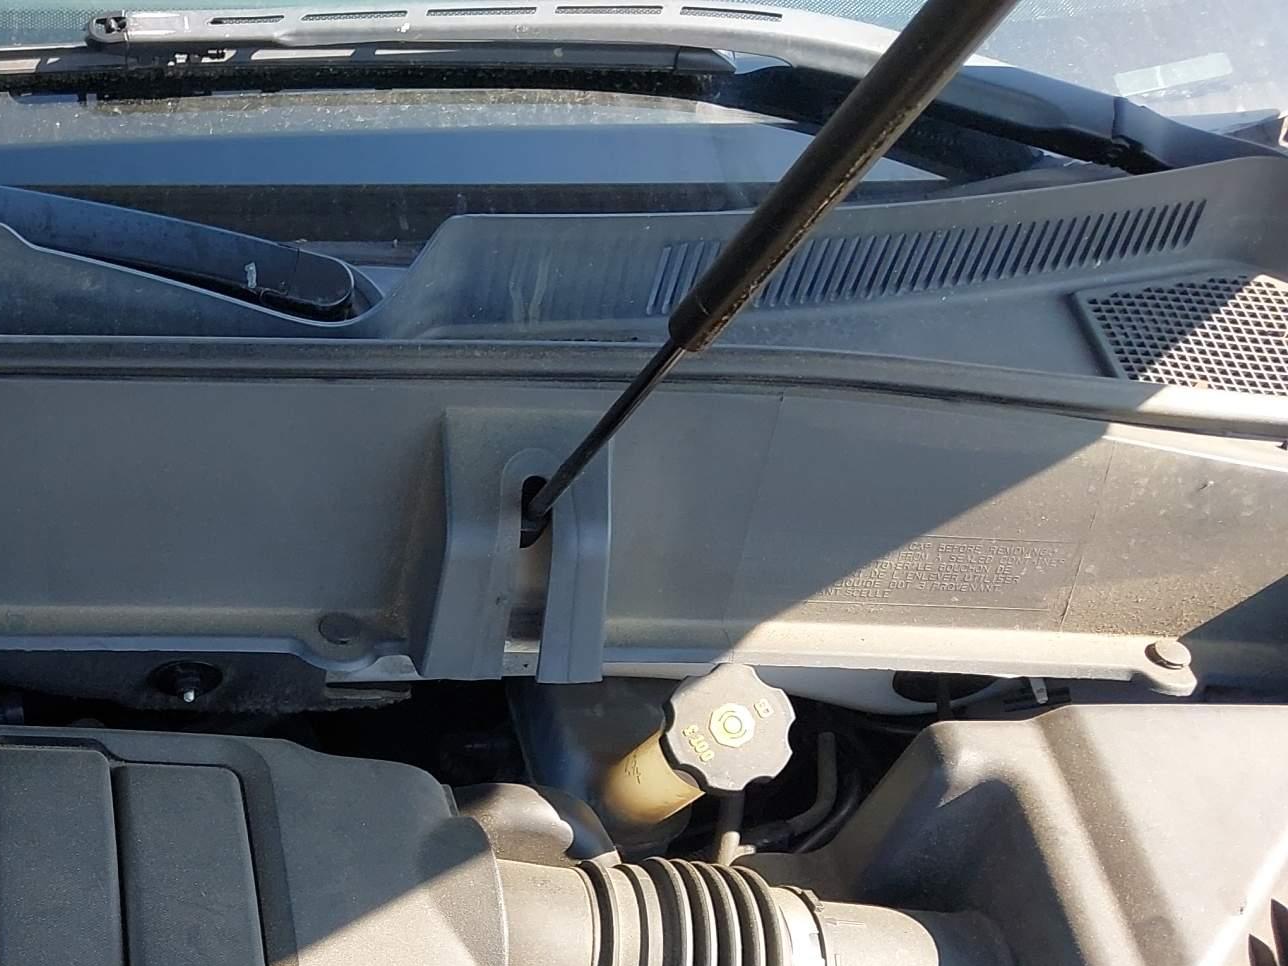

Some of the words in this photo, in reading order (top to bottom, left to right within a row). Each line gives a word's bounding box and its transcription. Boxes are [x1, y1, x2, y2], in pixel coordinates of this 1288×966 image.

[938, 543, 982, 554] BEFORE
[898, 551, 929, 562] FROM
[937, 563, 990, 573] BOUCHON
[997, 565, 1012, 574] DE
[963, 574, 1020, 584] UTILISER
